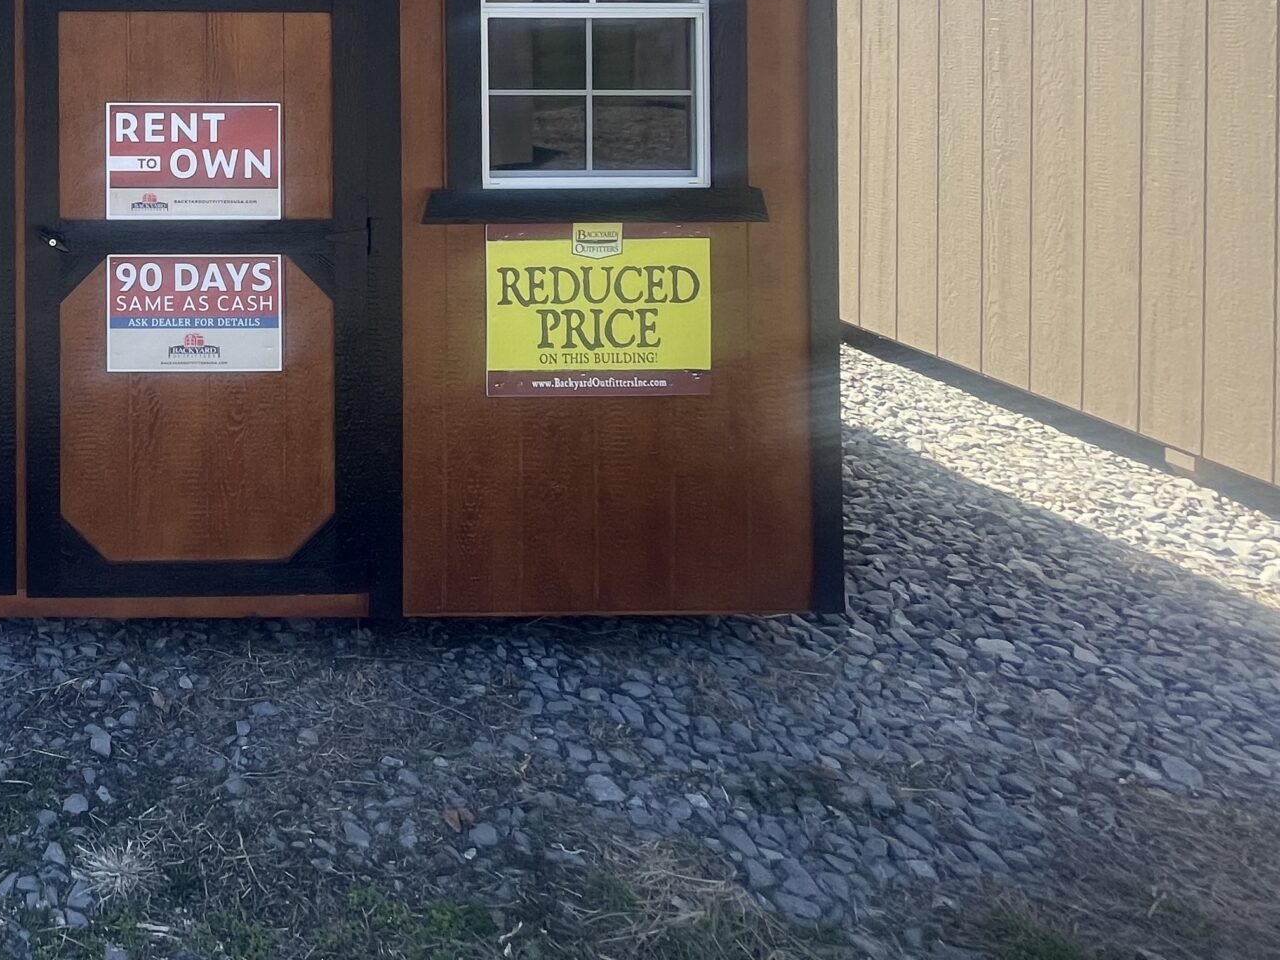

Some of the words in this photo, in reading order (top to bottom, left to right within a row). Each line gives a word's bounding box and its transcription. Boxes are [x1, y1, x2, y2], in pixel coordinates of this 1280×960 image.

[115, 112, 226, 143] RENT
[137, 158, 157, 169] TO
[169, 148, 271, 179] OWN
[577, 229, 618, 239] BACKYARD
[115, 262, 163, 292] 90
[174, 262, 272, 292] DAYS
[497, 265, 701, 307] REDUCED
[116, 295, 174, 312] SAME
[183, 295, 210, 312] AS
[217, 294, 273, 312] CASH
[128, 318, 148, 327] ASK
[151, 318, 191, 327] DEALER
[194, 318, 215, 327] FOR
[217, 317, 261, 327] DETAILS
[536, 308, 662, 351] PRICE
[539, 353, 558, 364] ON
[561, 352, 590, 364] THIS
[594, 352, 659, 364] BUILDING!
[531, 376, 667, 390] www.BackyardOutfittersInc.com
